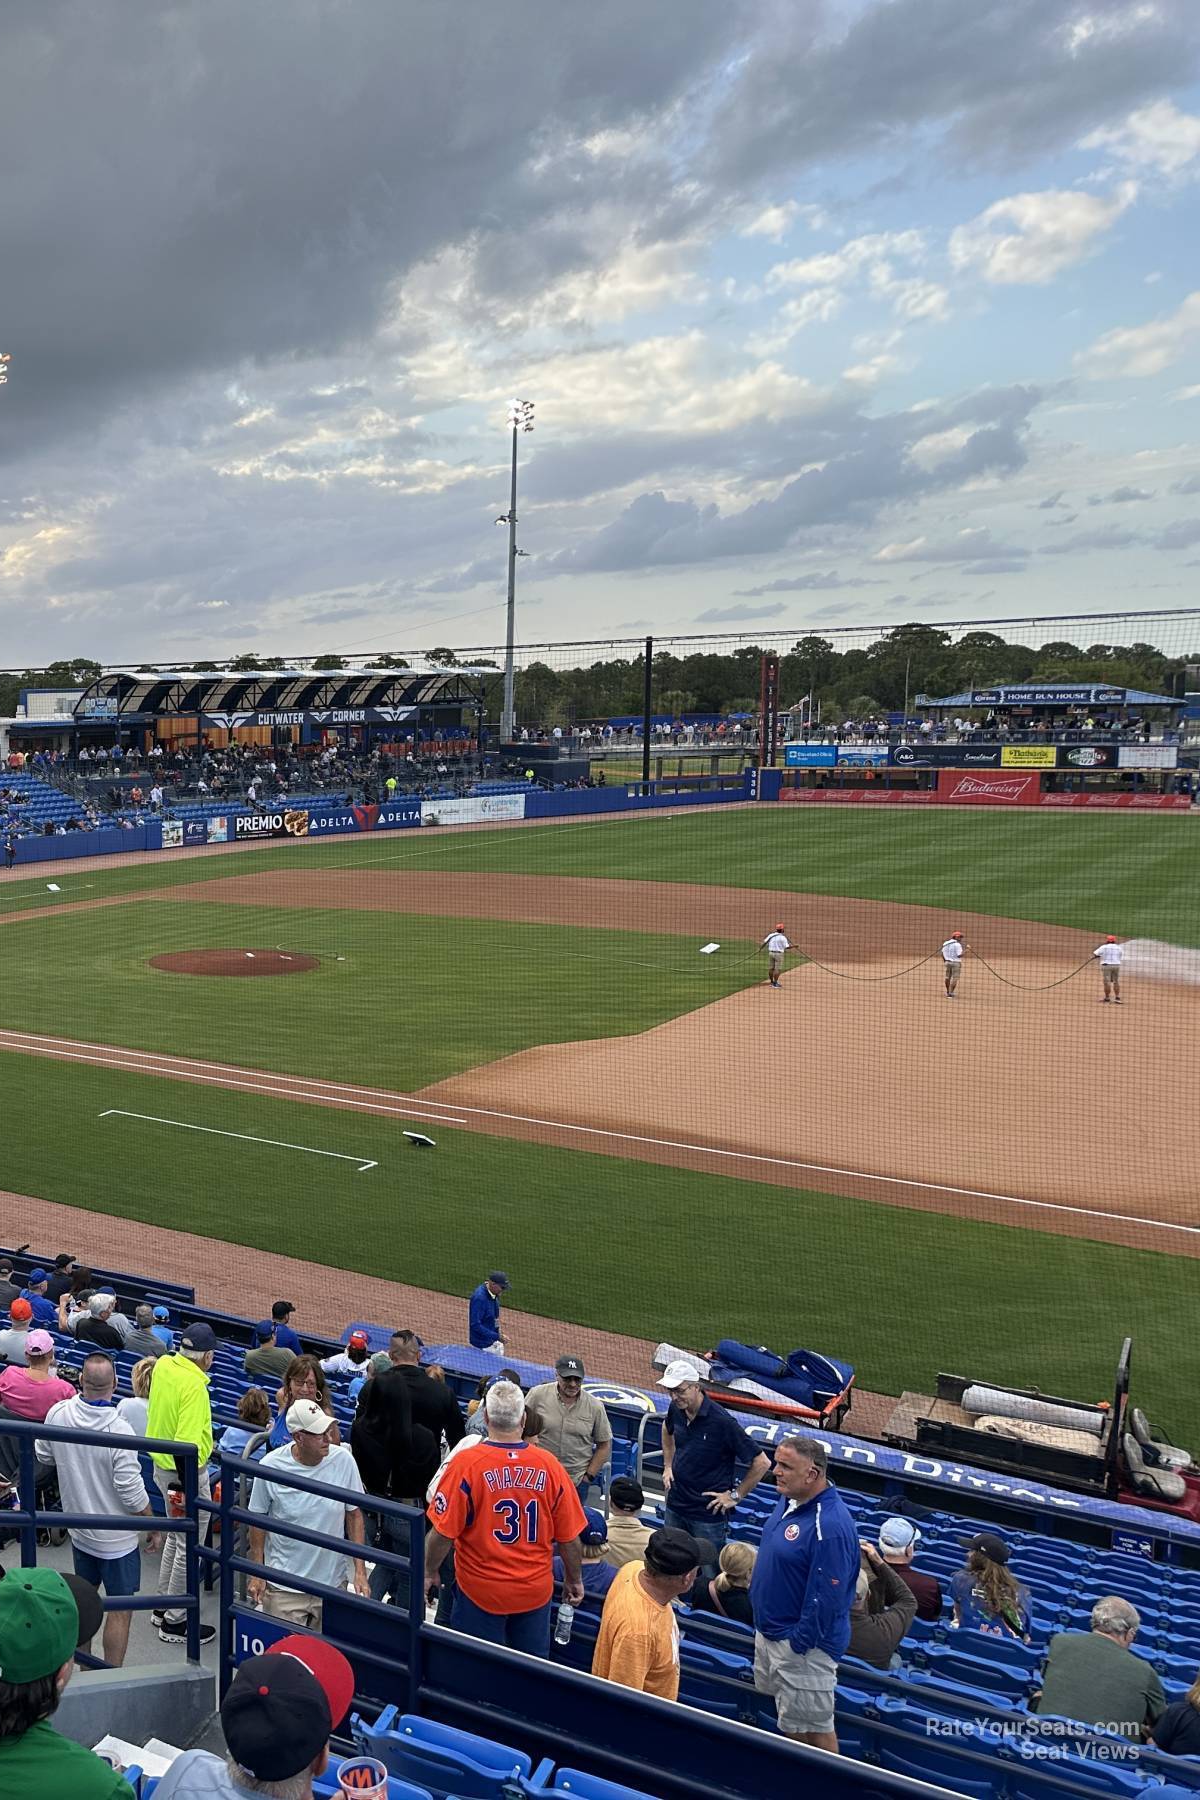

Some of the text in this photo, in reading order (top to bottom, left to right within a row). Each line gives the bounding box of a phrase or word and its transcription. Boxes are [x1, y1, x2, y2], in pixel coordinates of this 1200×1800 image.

[258, 711, 365, 725] CUTWATER CORNER
[959, 780, 1022, 793] Budweiser
[236, 815, 282, 831] PREMIO
[320, 816, 354, 827] DELTA
[388, 812, 420, 822] DELTA
[483, 1466, 547, 1492] PIAZZA
[493, 1498, 538, 1544] 31
